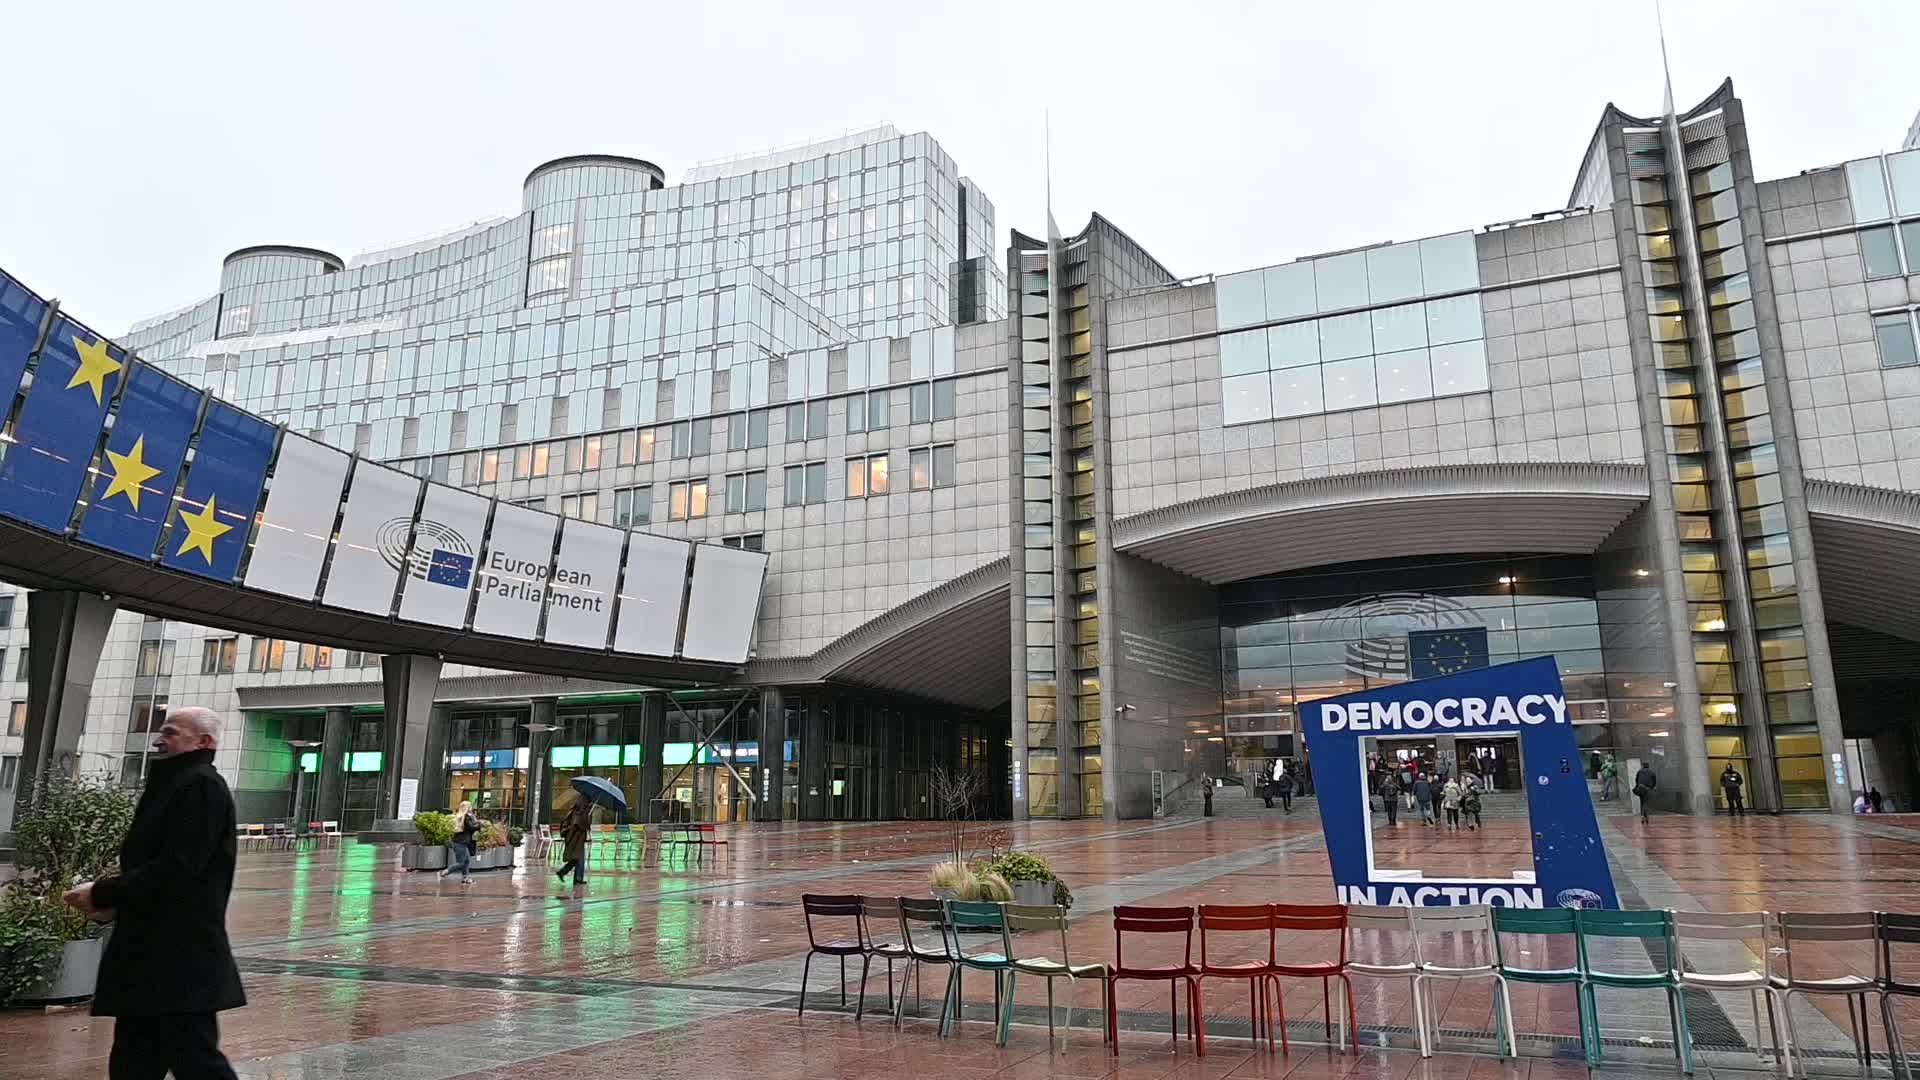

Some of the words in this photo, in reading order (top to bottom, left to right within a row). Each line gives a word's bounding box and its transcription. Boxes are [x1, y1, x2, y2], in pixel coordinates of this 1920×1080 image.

[491, 551, 591, 587] European
[486, 576, 602, 612] Parliament
[1321, 694, 1566, 731] DEMOCRACY
[1338, 886, 1377, 906] IN
[1388, 886, 1543, 909] ACTION
